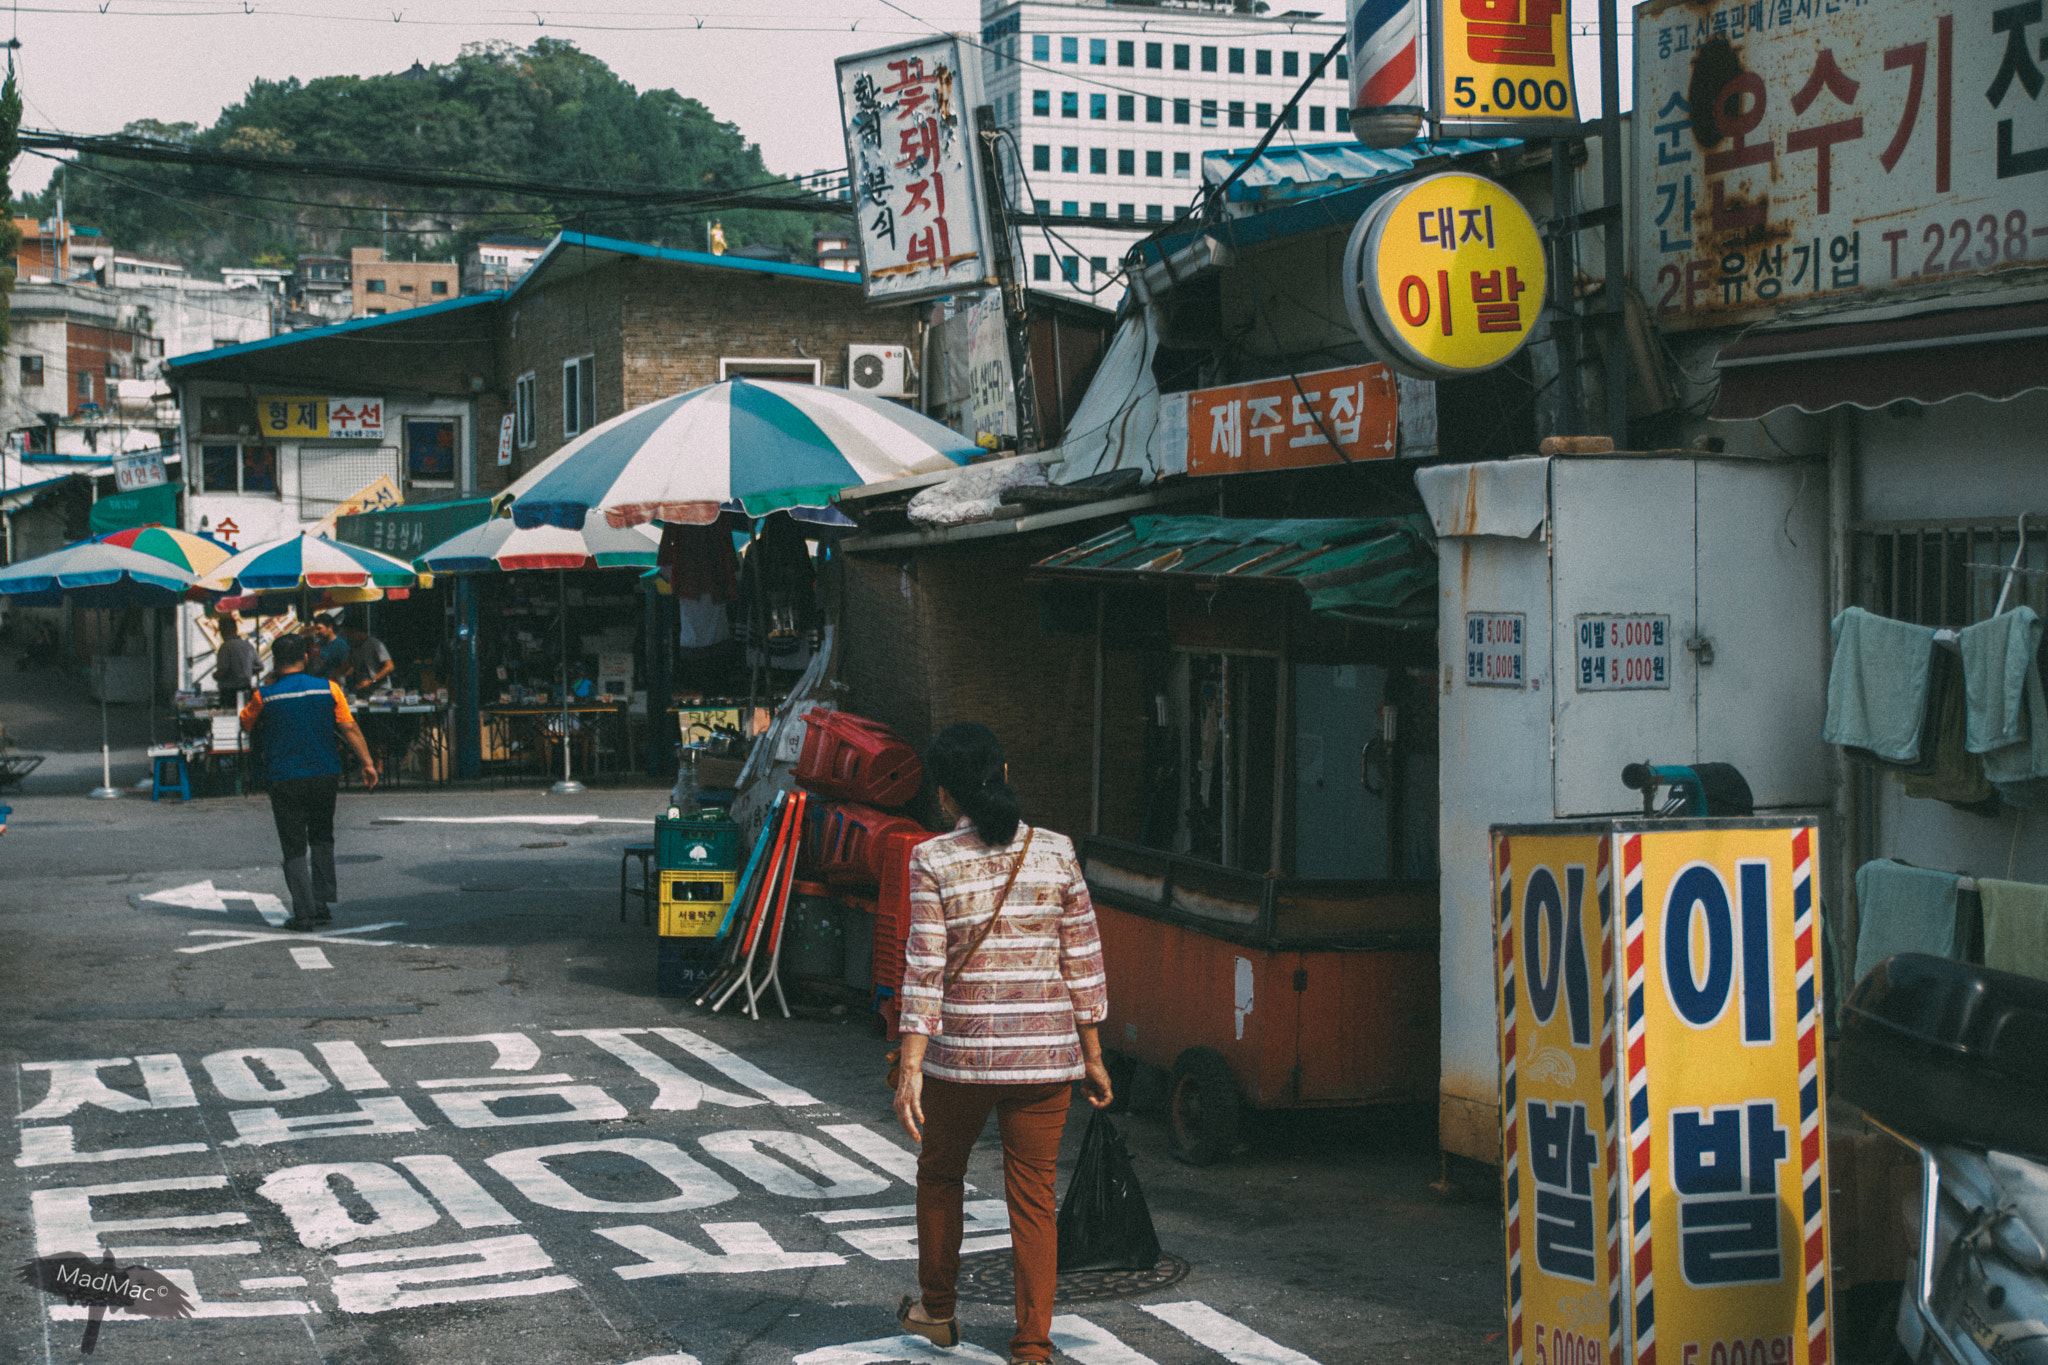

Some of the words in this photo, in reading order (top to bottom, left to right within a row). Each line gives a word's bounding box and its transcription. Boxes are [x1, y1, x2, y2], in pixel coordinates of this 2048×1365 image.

[1454, 76, 1568, 112] 5.000
[1653, 90, 1696, 254] 순간
[866, 166, 896, 251] 분식
[1418, 204, 1496, 252] 대지
[1718, 230, 1861, 305] 유성기업
[1397, 266, 1526, 337] 이발
[267, 400, 329, 431] 형제
[331, 403, 381, 429] 수선
[1209, 381, 1365, 459] 제주도집
[121, 464, 161, 486] 여인숙
[1468, 619, 1485, 645] 이발
[1486, 619, 1522, 646] 5,000원
[1581, 621, 1605, 649] 이발
[1611, 621, 1665, 649] 5,000원
[1468, 651, 1484, 678] 염색
[1486, 654, 1522, 681] 5,000원
[1581, 656, 1606, 684] 염색
[1611, 656, 1665, 685] 5,000원
[678, 910, 717, 921] 서울탁주
[14, 1026, 823, 1168] 진입금지
[1522, 863, 1600, 1287] 이발
[1658, 856, 1791, 1292] 이발
